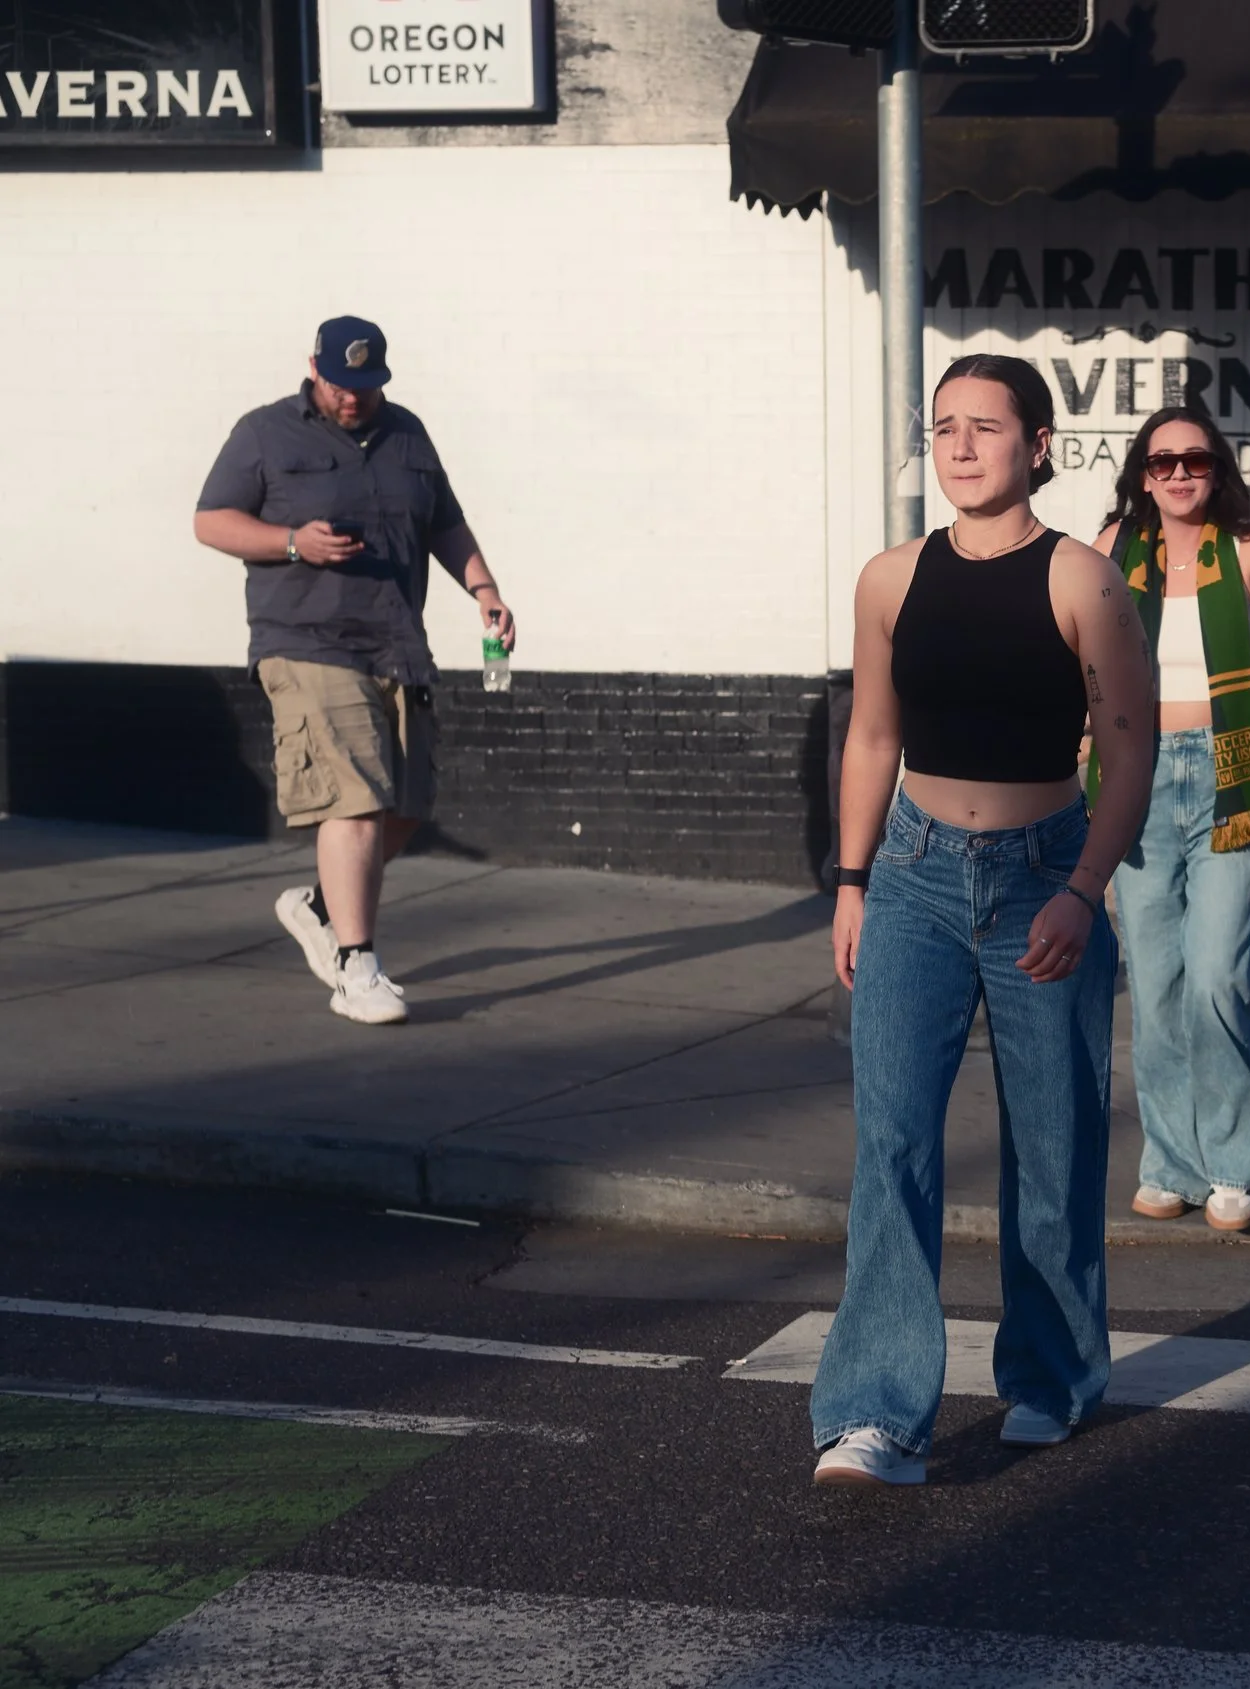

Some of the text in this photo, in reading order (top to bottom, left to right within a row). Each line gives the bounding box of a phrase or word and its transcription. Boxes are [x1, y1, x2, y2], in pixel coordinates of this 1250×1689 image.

[350, 24, 504, 51] OREGON
[369, 63, 488, 84] LOTTERY
[0, 70, 253, 118] VERNA
[1062, 437, 1136, 471] BA
